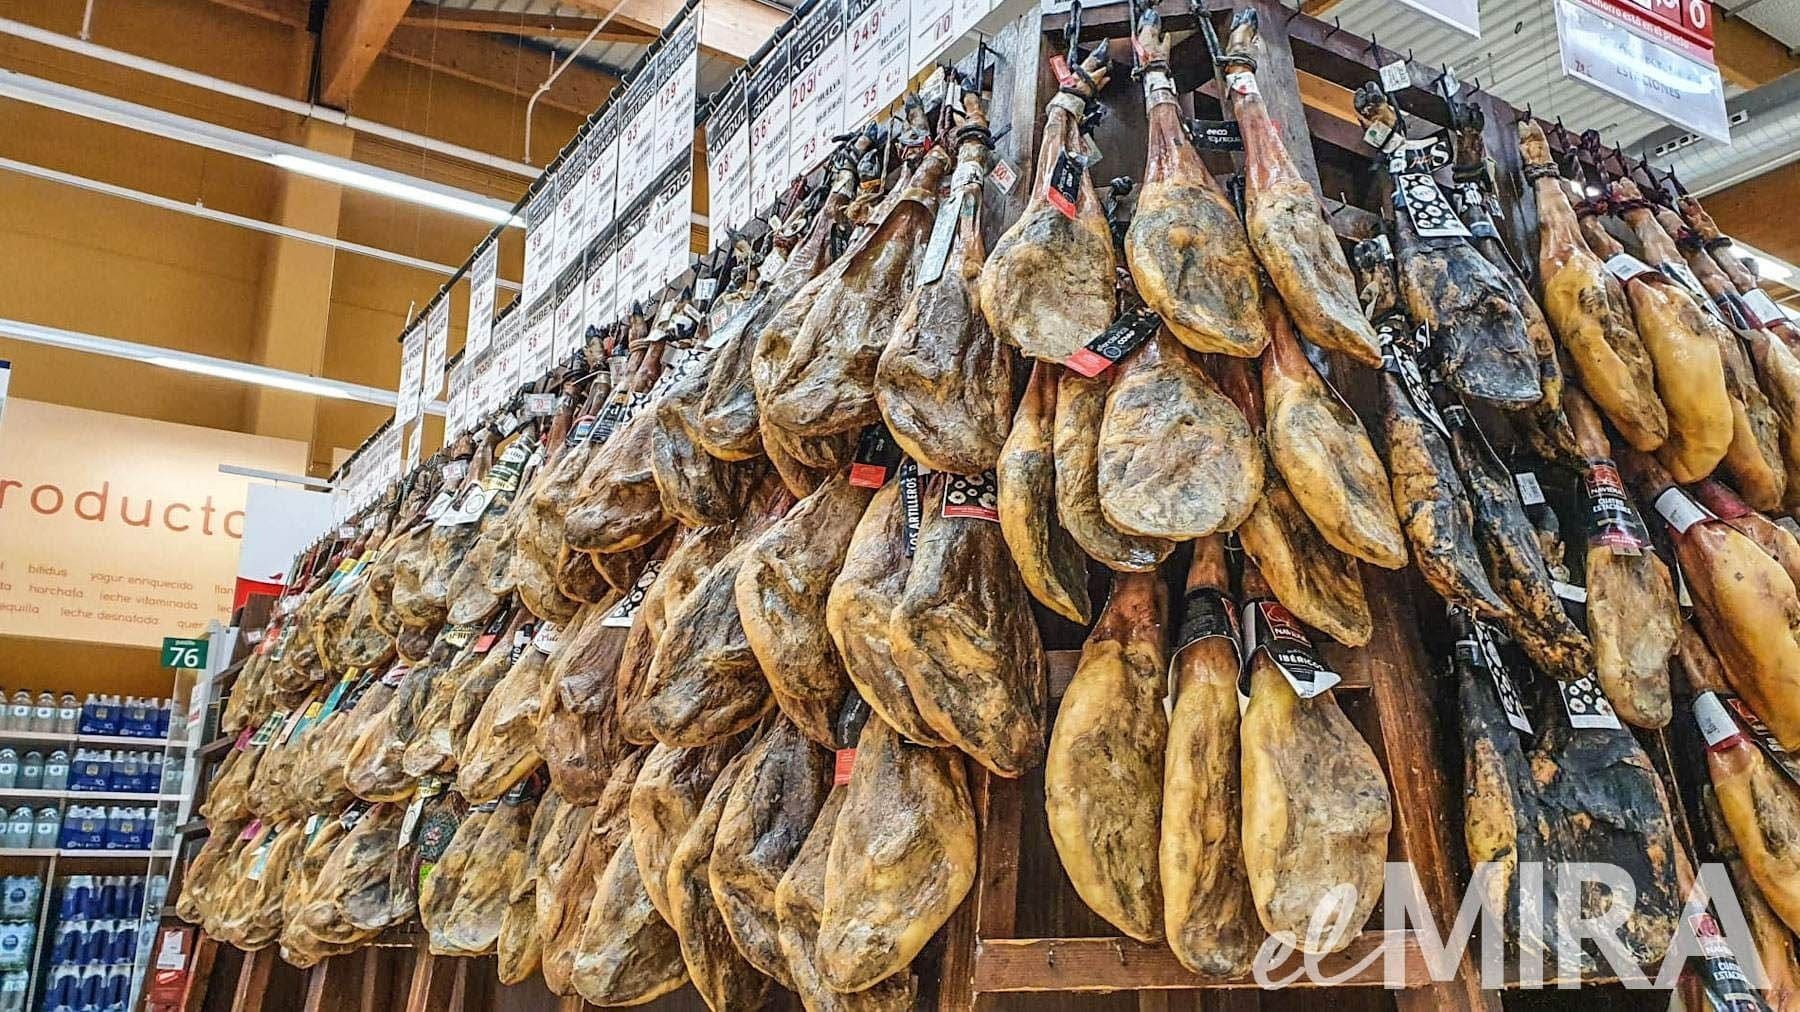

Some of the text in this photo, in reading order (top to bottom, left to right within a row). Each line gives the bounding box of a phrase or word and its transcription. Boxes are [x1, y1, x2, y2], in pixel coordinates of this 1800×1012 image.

[853, 11, 879, 52] 249
[792, 72, 814, 109] 205
[863, 84, 877, 108] 35
[803, 137, 815, 160] 23
[905, 477, 919, 530] ARTILLEROS
[90, 572, 125, 584] yogur
[29, 584, 84, 599] horchata
[100, 592, 131, 603] leche
[136, 596, 199, 610] vitaminada
[60, 607, 93, 618] leche
[169, 647, 199, 668] 76
